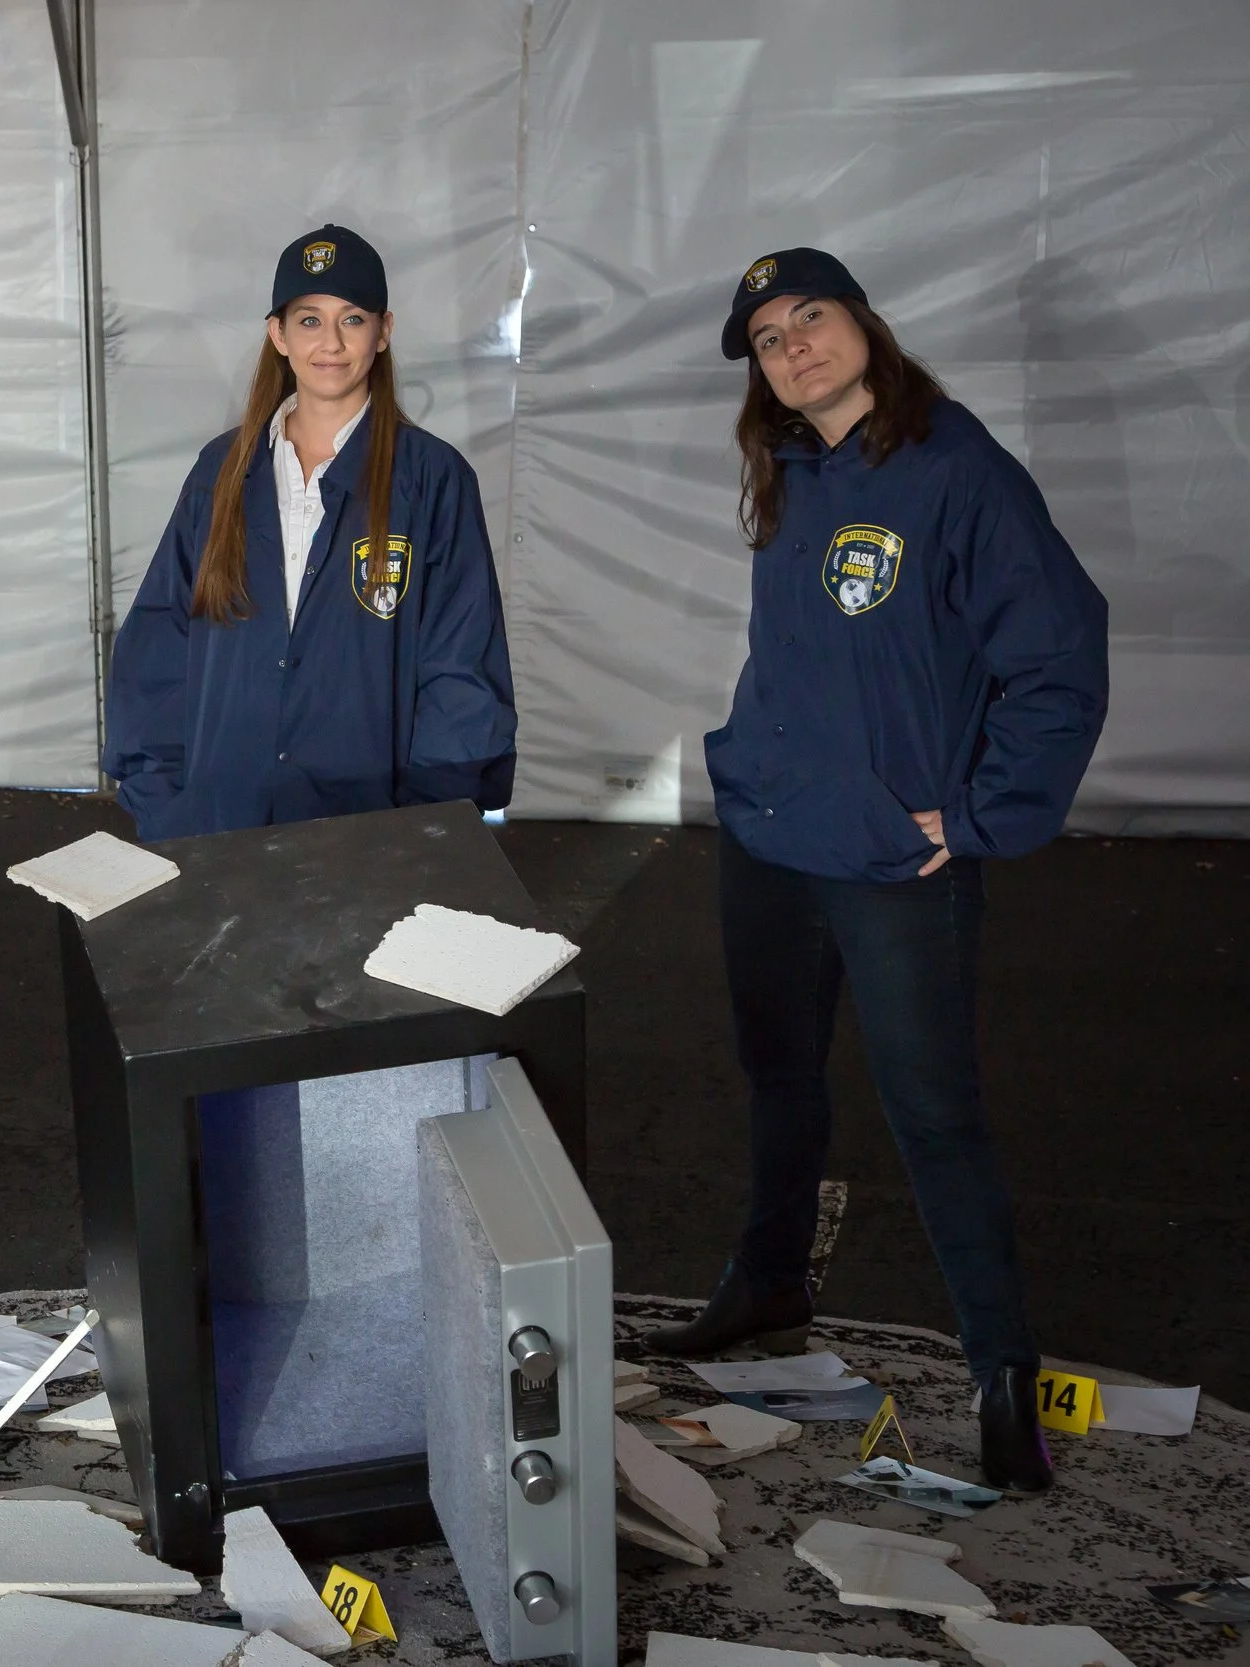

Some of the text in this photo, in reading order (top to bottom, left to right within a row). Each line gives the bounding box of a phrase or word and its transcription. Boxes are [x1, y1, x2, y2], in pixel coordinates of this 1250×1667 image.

[841, 563, 876, 579] FORCE
[847, 551, 876, 567] TASK
[1040, 1378, 1077, 1416] 14
[330, 1581, 358, 1626] 18
